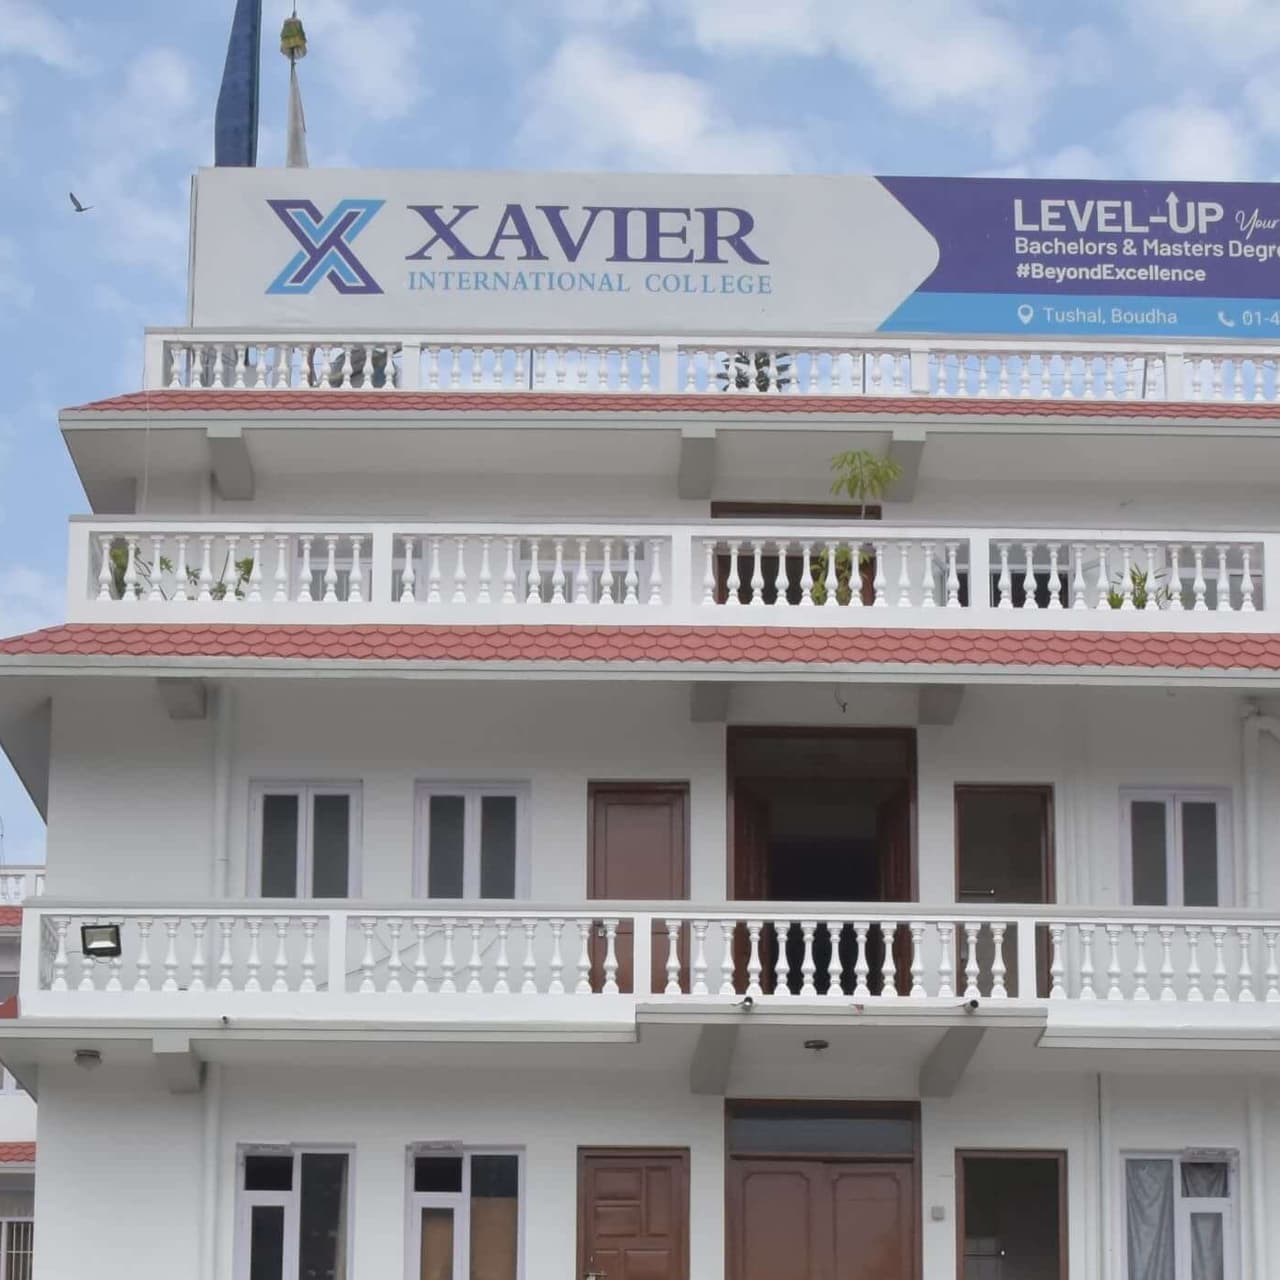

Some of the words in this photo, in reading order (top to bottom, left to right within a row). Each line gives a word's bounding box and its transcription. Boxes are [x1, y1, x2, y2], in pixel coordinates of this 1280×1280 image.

[1014, 195, 1223, 234] LEVEL-UP
[1235, 208, 1280, 240] Your
[405, 204, 770, 265] XAVIER
[1014, 237, 1118, 257] Bachelors
[1122, 239, 1138, 256] &
[1143, 239, 1224, 258] Masters
[408, 270, 631, 293] INTERNATIONAL
[645, 273, 772, 295] COLLEGE
[1016, 263, 1206, 283] #BeyondExcellence
[1043, 307, 1106, 325] Tushal,
[1111, 308, 1178, 325] Boudha
